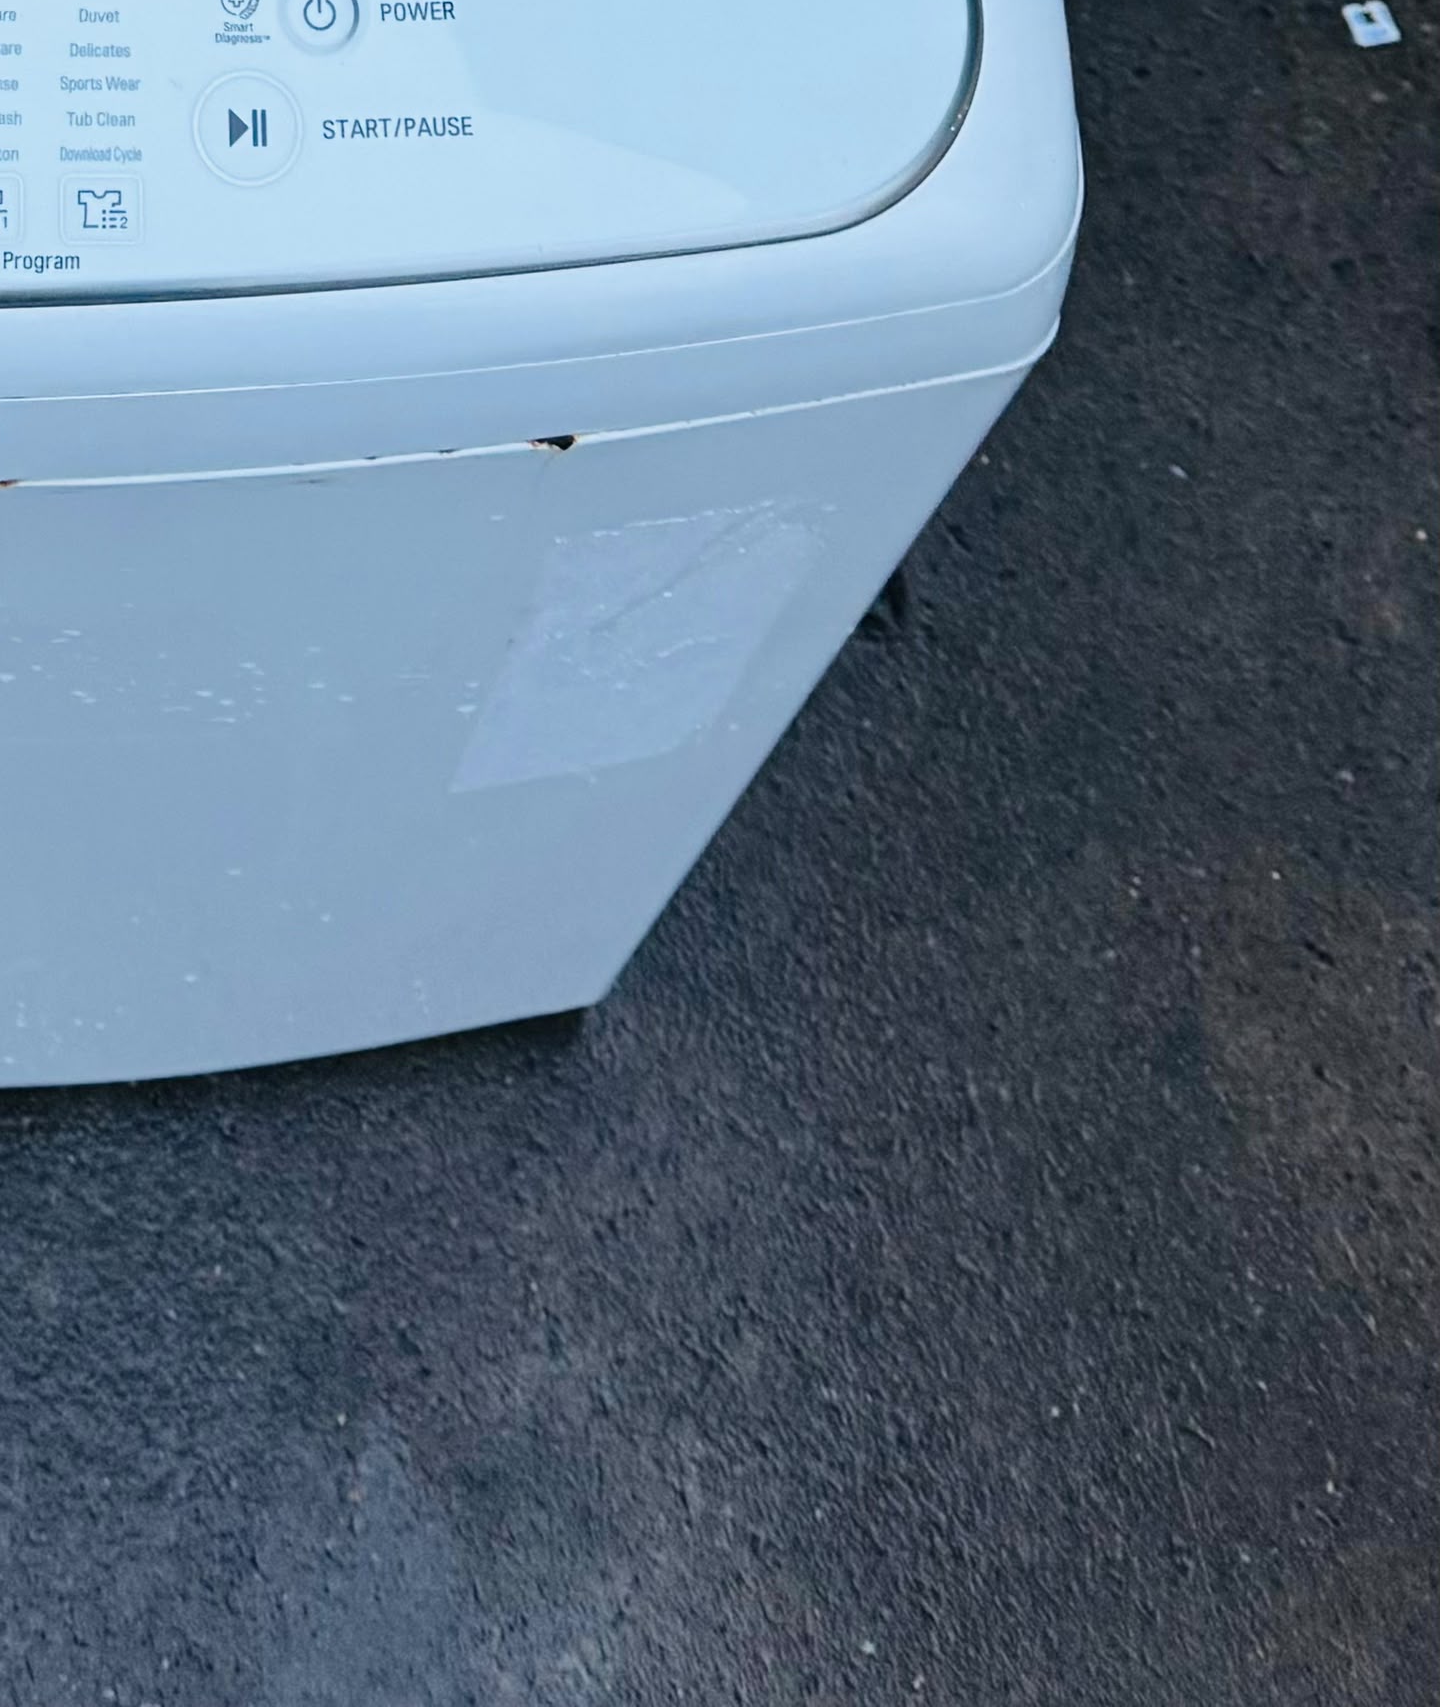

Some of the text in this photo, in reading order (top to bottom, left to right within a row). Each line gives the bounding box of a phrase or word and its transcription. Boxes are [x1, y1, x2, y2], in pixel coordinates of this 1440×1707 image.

[78, 8, 120, 23] Duvet
[380, 1, 456, 22] POWER
[223, 21, 254, 32] Smart
[69, 42, 131, 58] Delicates
[59, 75, 141, 94] Sports Wear
[66, 111, 136, 127] Tub Clean
[322, 116, 474, 140] START/PAUSE
[59, 146, 143, 164] Download Cycle
[2, 251, 81, 274] Program
